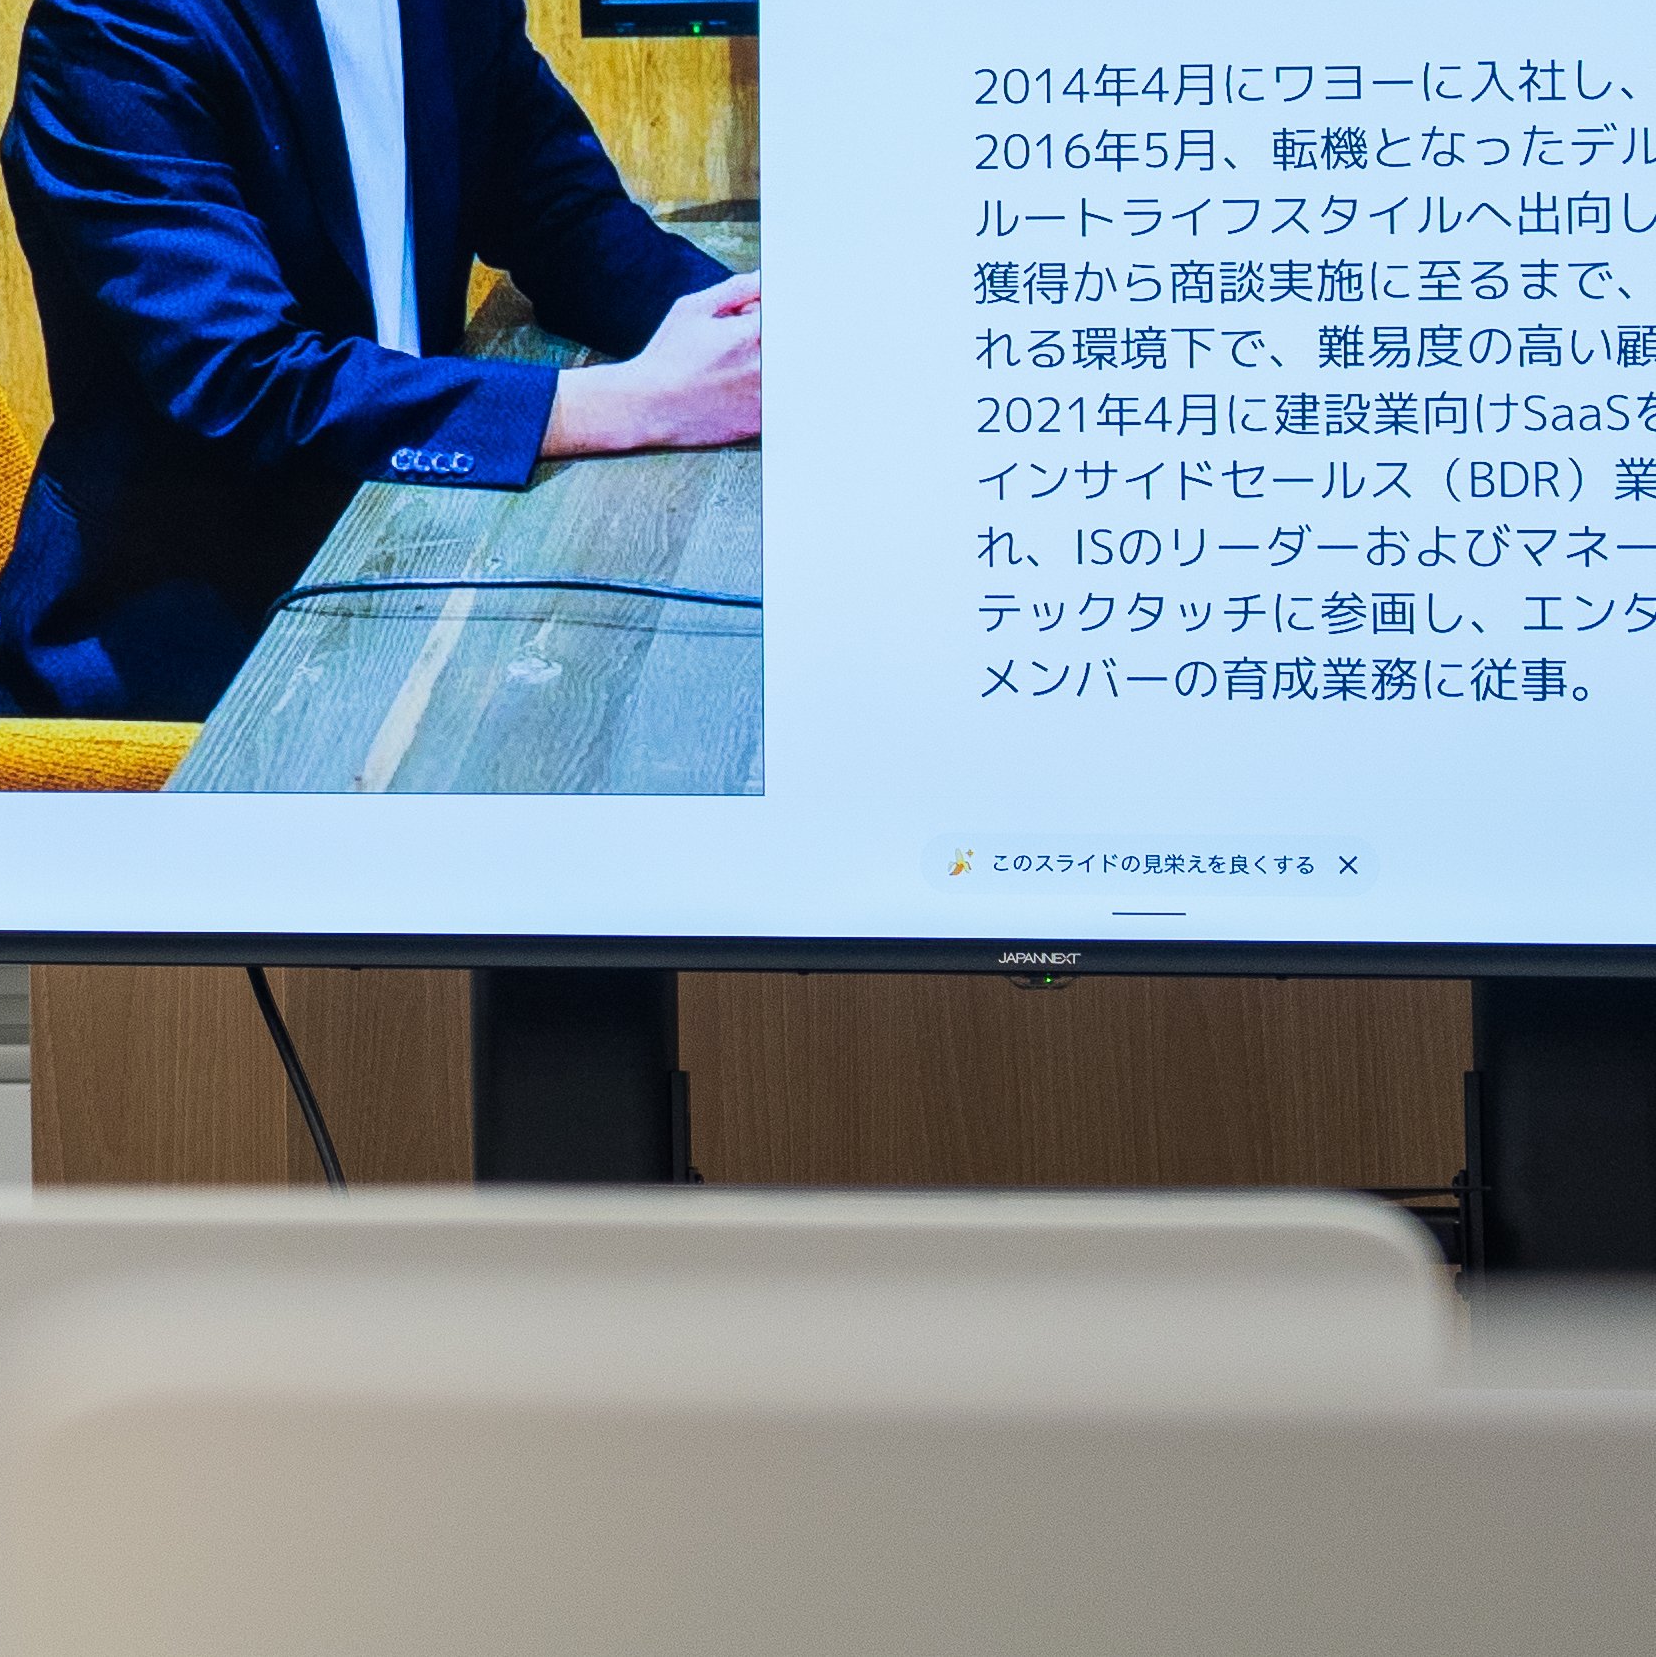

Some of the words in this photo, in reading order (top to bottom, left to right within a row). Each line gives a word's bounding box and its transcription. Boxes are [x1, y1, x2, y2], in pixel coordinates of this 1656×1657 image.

[975, 59, 1633, 106] 2014年4月にワヨーに入社し、
[976, 123, 1656, 172] 2016年5月、転機となったデル
[976, 191, 1656, 237] ルートライフスタイルへ出向し
[974, 259, 1630, 304] 獲得から商談実施に至るまで、
[976, 323, 1656, 370] れる環境下で、難易度の高い顧
[979, 457, 1656, 502] インサイドセールス（BDR）業
[978, 524, 1656, 567] れ、ISのリーダーおよびマネー
[979, 591, 1656, 634] テックタッチに参画し、エンタ
[982, 656, 1588, 701] メンバーの育成業務に従事。
[994, 854, 1314, 874] このスライドの見栄えを良くする
[998, 952, 1082, 965] JAPANNEXT
